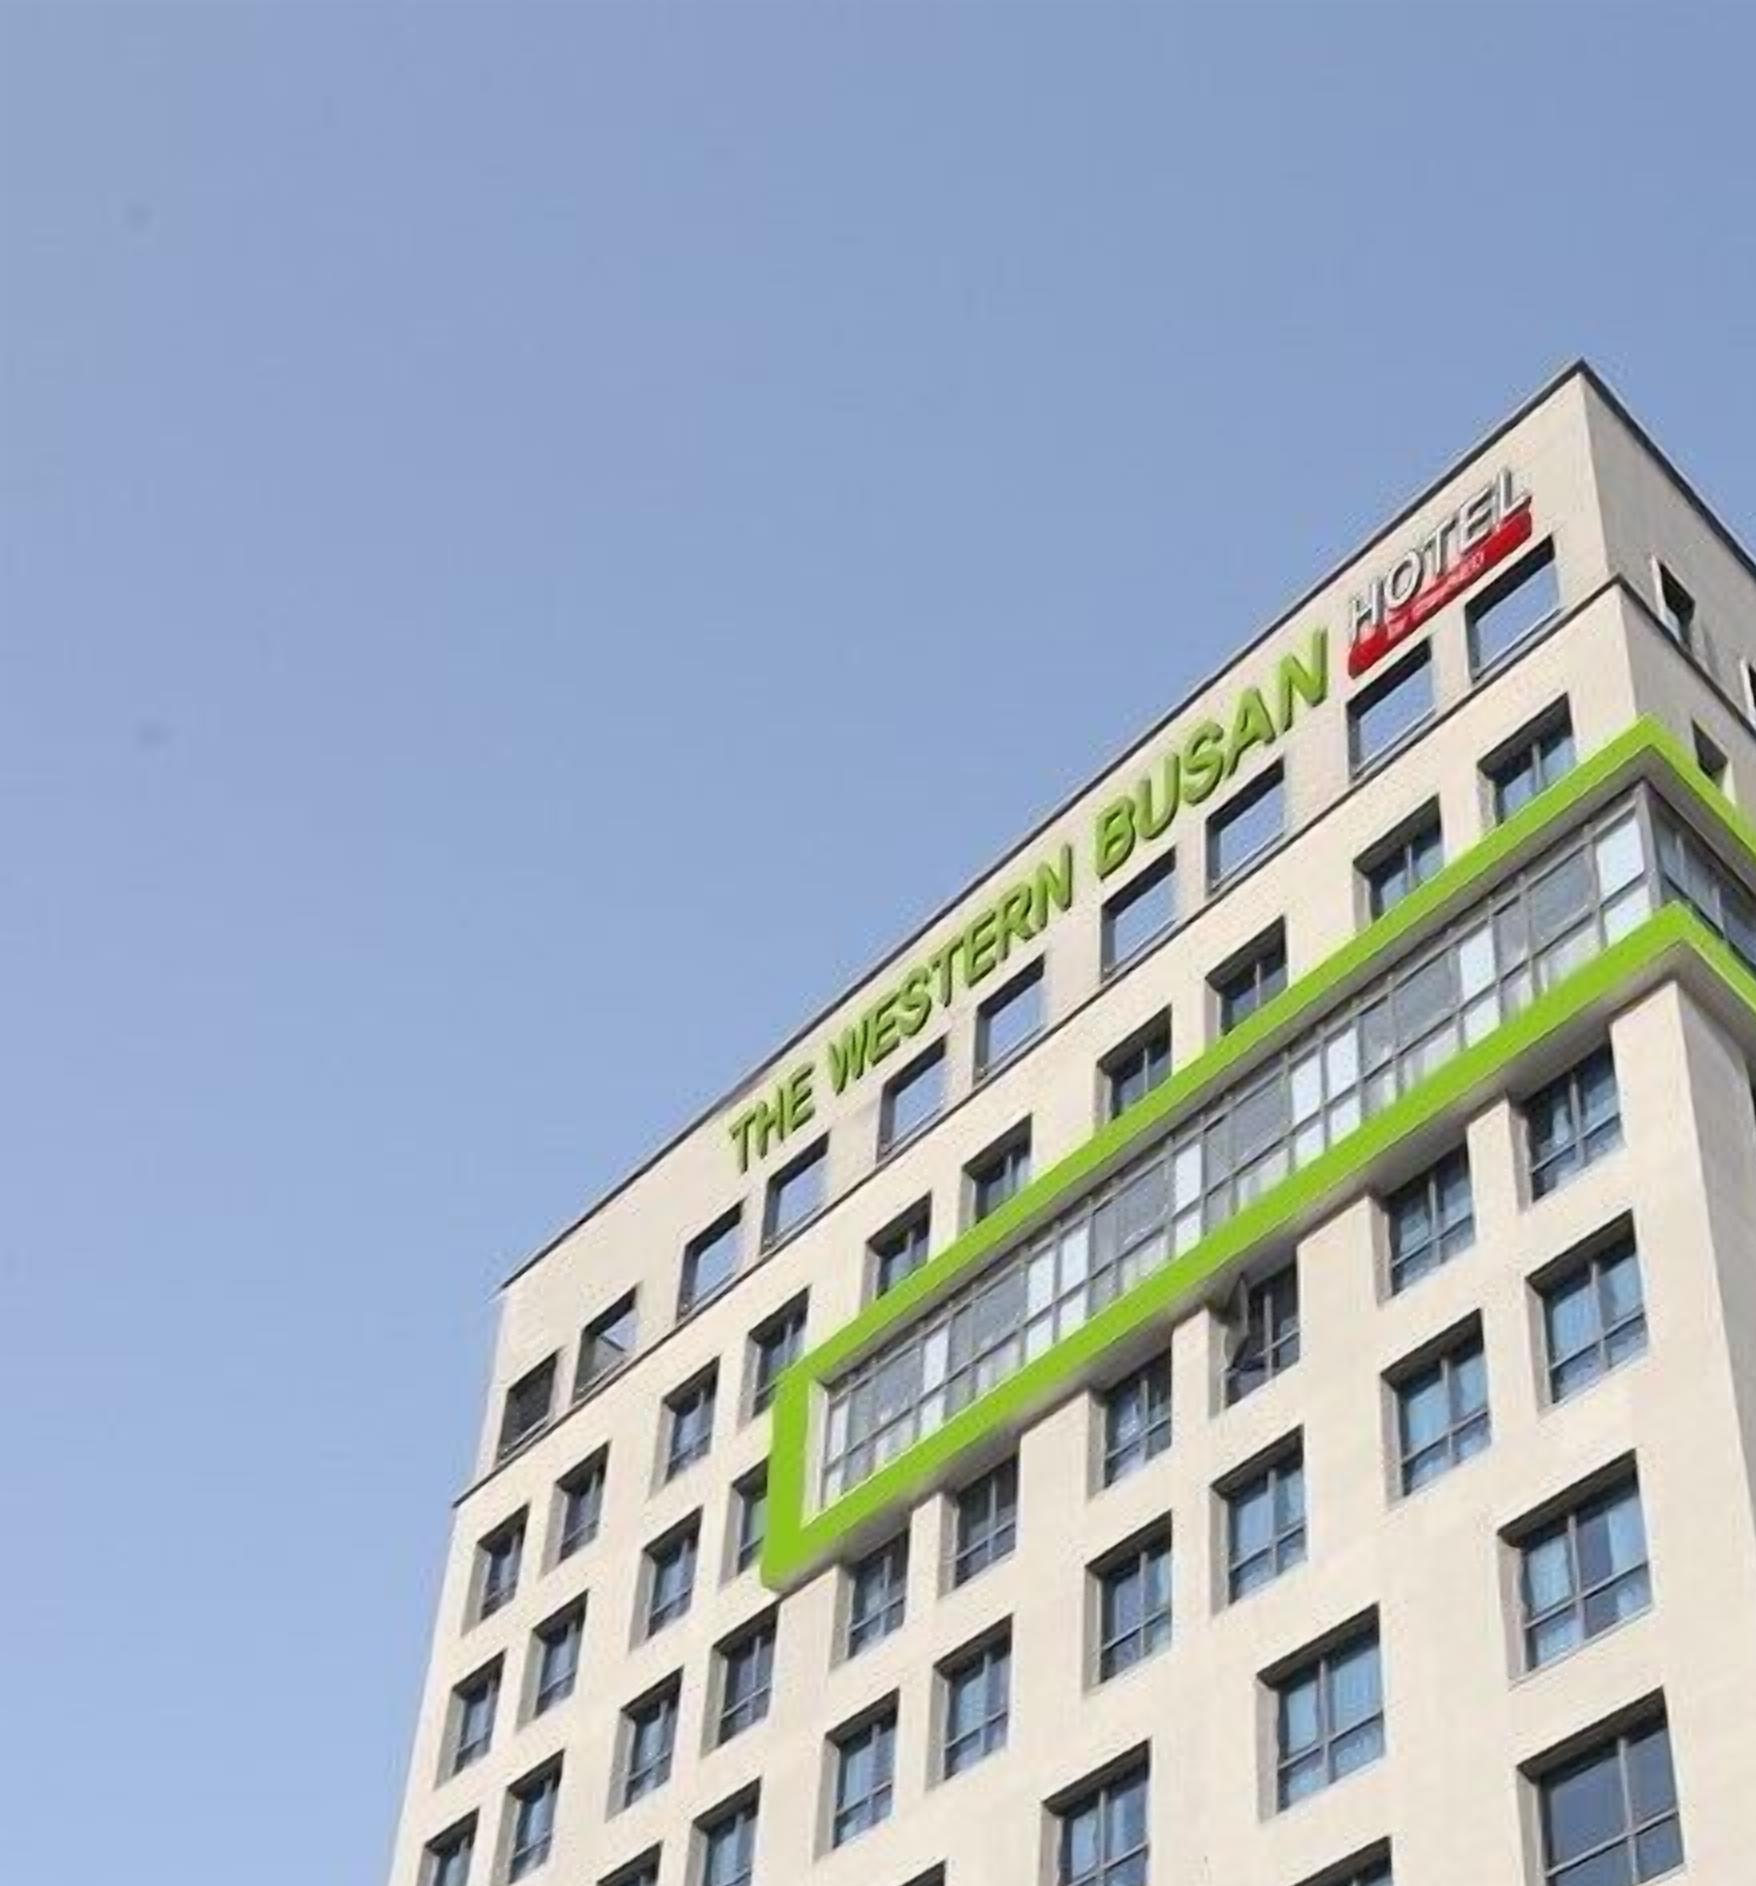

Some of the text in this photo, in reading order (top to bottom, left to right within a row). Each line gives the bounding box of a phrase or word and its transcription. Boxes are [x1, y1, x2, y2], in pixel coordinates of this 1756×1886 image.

[729, 1062, 816, 1174] THE
[828, 842, 1074, 1096] WESTERN
[1095, 627, 1329, 881] BUSAN
[1349, 466, 1532, 642] HOTEL
